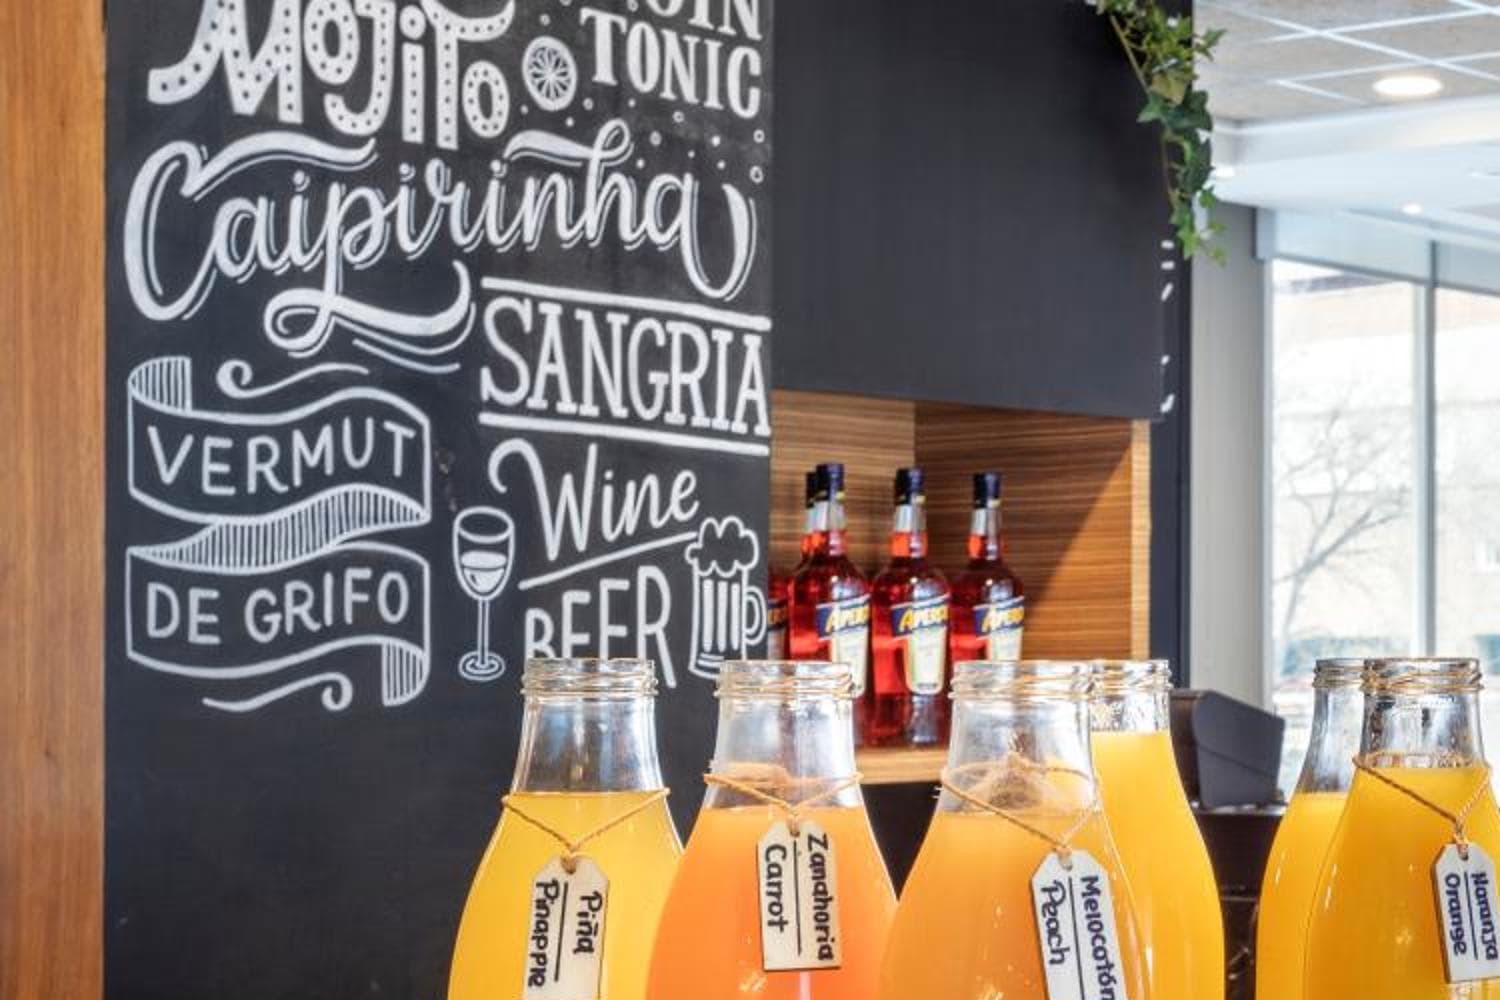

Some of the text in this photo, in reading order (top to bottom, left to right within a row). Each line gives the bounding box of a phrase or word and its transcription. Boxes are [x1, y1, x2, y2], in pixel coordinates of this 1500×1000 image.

[579, 7, 761, 119] TONIC
[124, 119, 756, 356] Caipirinha
[480, 295, 771, 436] SANGRIA
[147, 417, 416, 495] VERMUT
[488, 438, 700, 561] Wine
[147, 567, 410, 644] DE GRIFO
[525, 565, 677, 688] BEER
[573, 890, 603, 954] Piña
[765, 844, 789, 933] Carrot
[807, 833, 836, 961] Zanahoria
[1041, 879, 1071, 965] Peach
[1444, 873, 1468, 957] Orange
